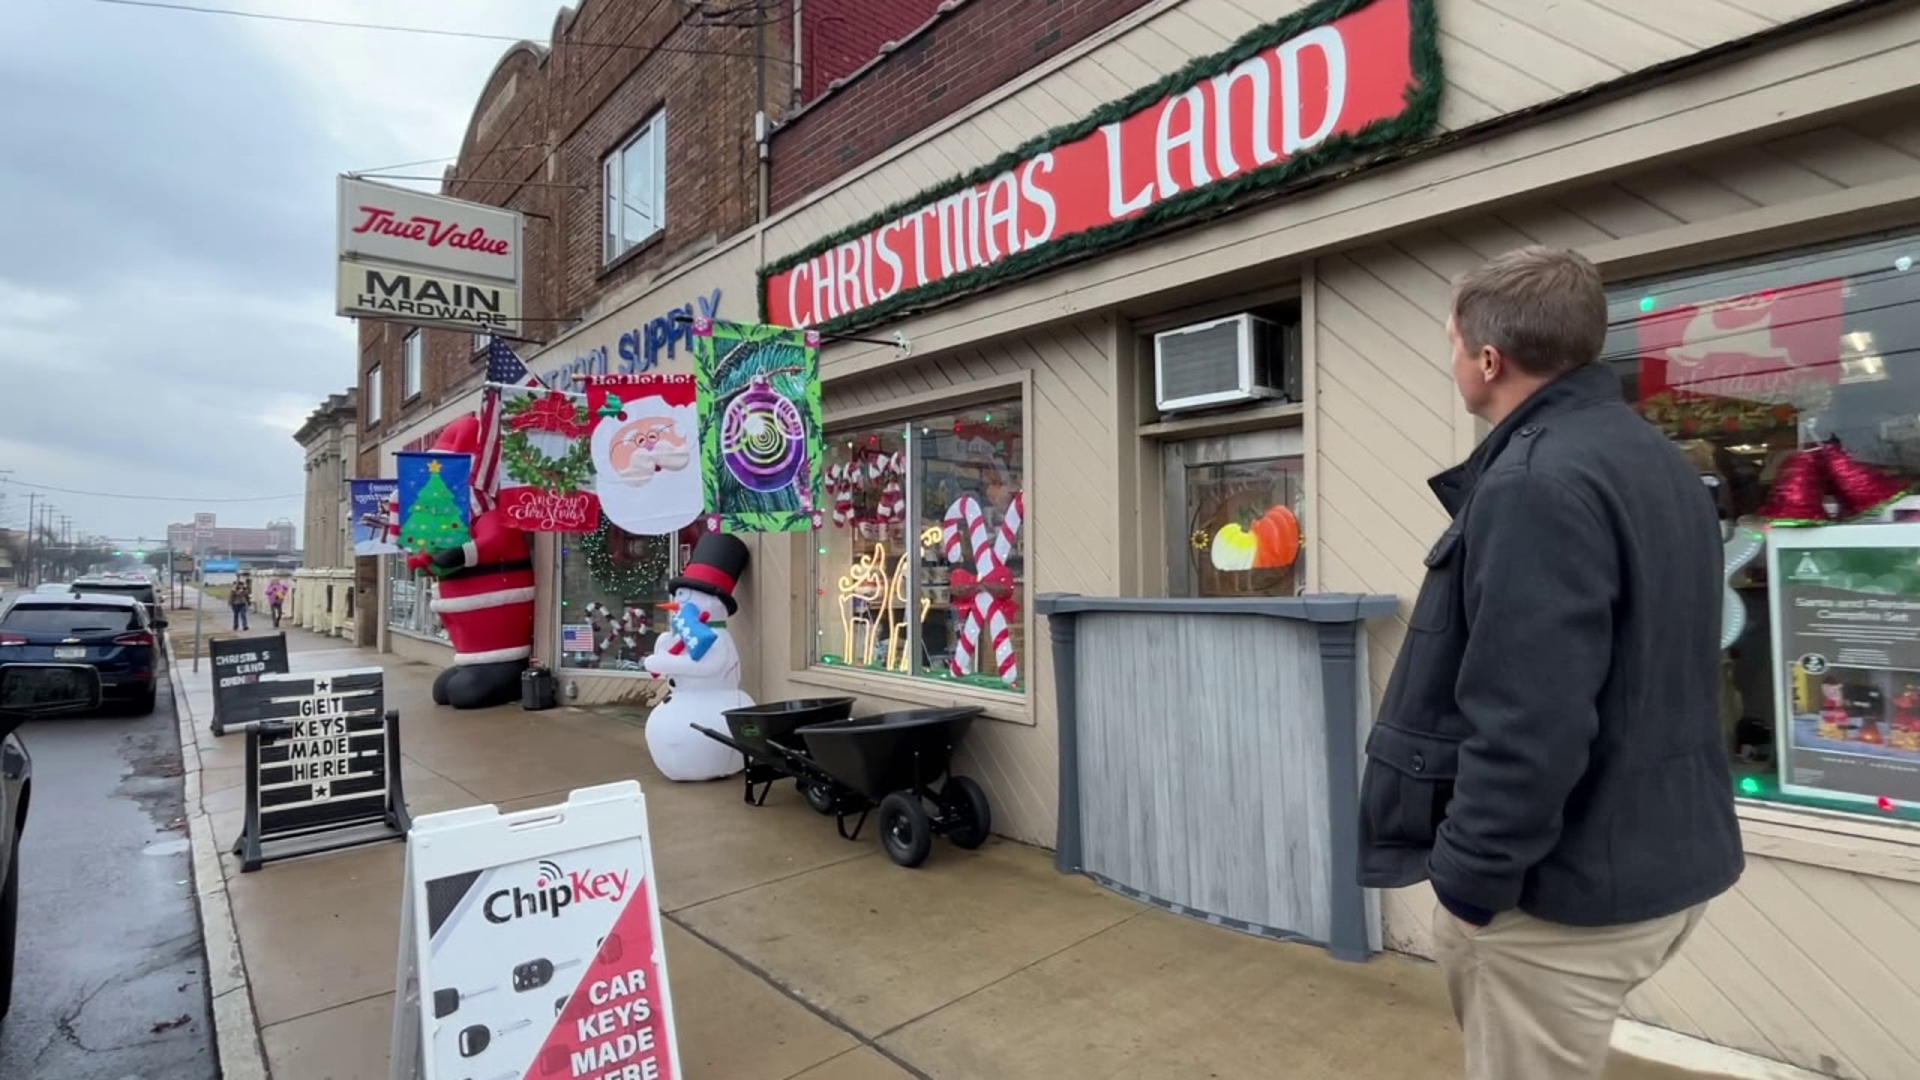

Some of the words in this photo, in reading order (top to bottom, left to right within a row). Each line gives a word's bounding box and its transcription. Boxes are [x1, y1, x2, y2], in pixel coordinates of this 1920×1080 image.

[788, 152, 1056, 330] CHRISTMAS
[1098, 25, 1347, 219] LAND
[365, 269, 500, 313] MAIN
[357, 294, 508, 327] HARDWARE
[591, 374, 622, 386] Ho!
[627, 374, 656, 385] Ho!
[662, 373, 691, 385] Ho!
[301, 697, 342, 717] GET
[294, 718, 345, 738] KEYS
[290, 738, 347, 760] MADE
[294, 760, 347, 781] HERE
[482, 867, 630, 925] ChipKey
[588, 968, 647, 1006] CAR
[576, 997, 651, 1042] KEYS
[569, 1026, 655, 1077] MADE
